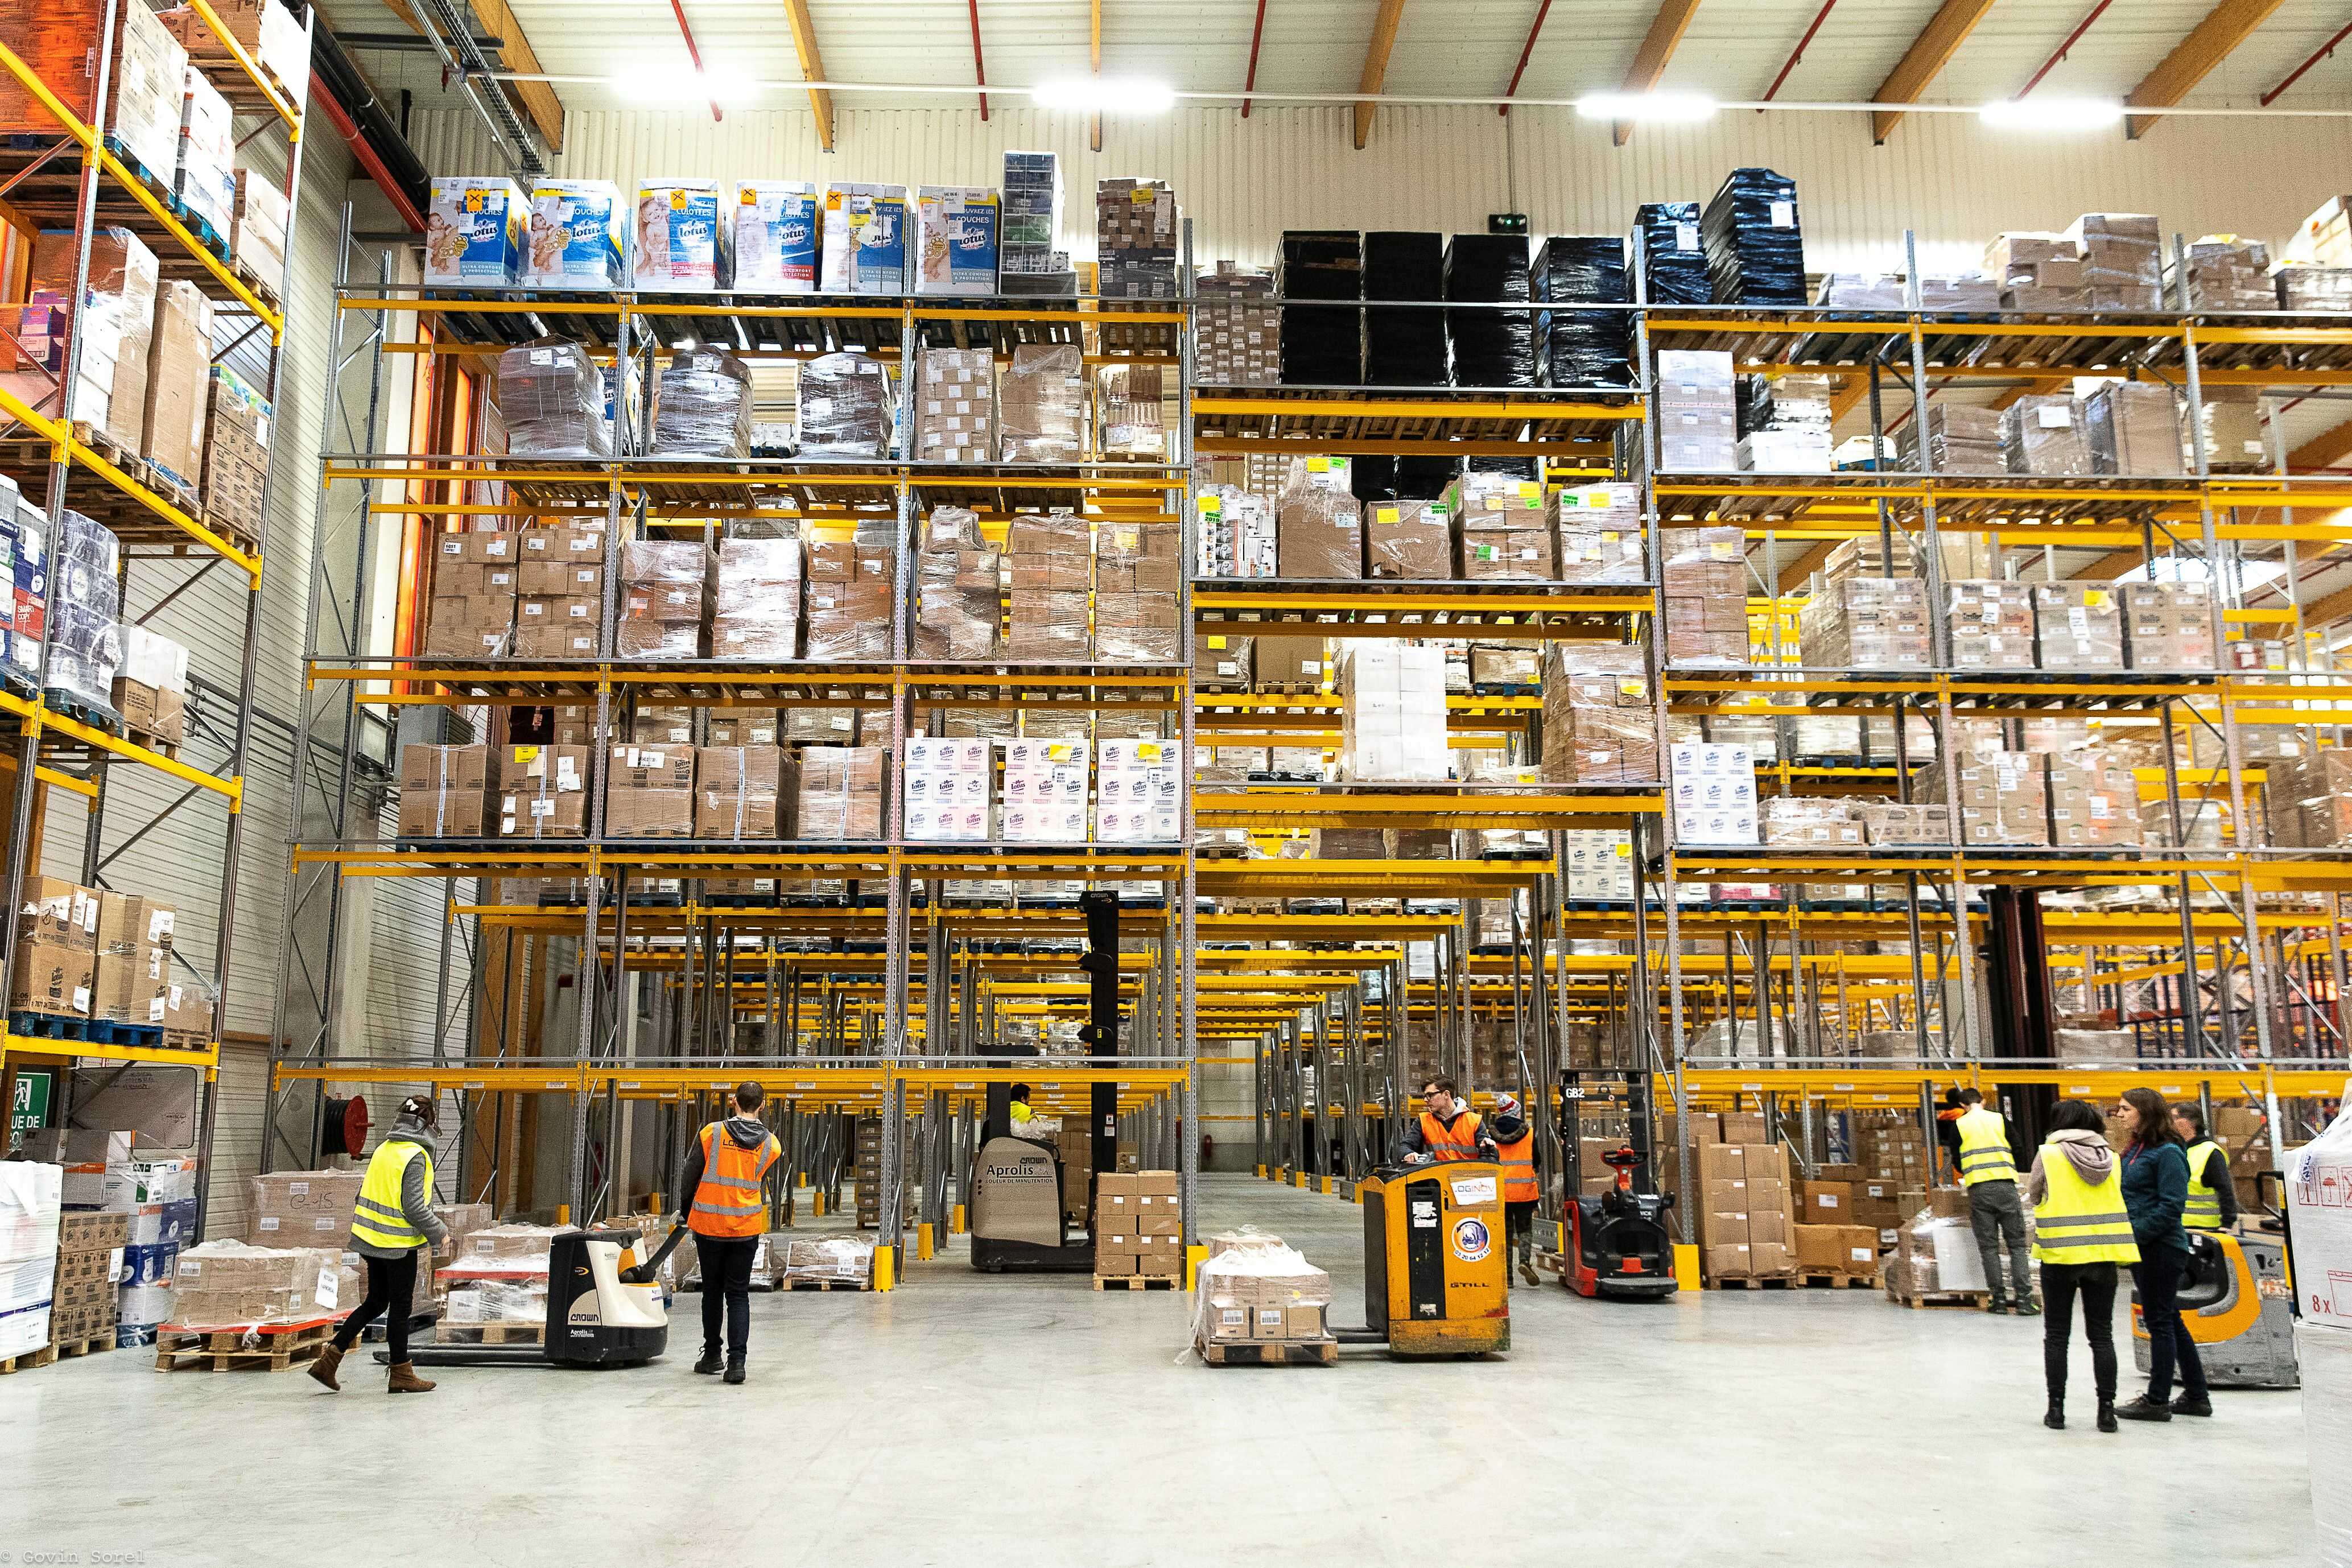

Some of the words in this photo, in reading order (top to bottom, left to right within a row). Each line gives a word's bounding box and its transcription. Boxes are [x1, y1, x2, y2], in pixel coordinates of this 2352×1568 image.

[573, 228, 600, 238] lotus
[679, 228, 707, 237] lotus
[17, 605, 34, 613] SMART
[1566, 1088, 1585, 1098] GB2
[27, 1115, 40, 1129] DE
[987, 1165, 1034, 1178] Aprolis
[2312, 1295, 2320, 1313] 8
